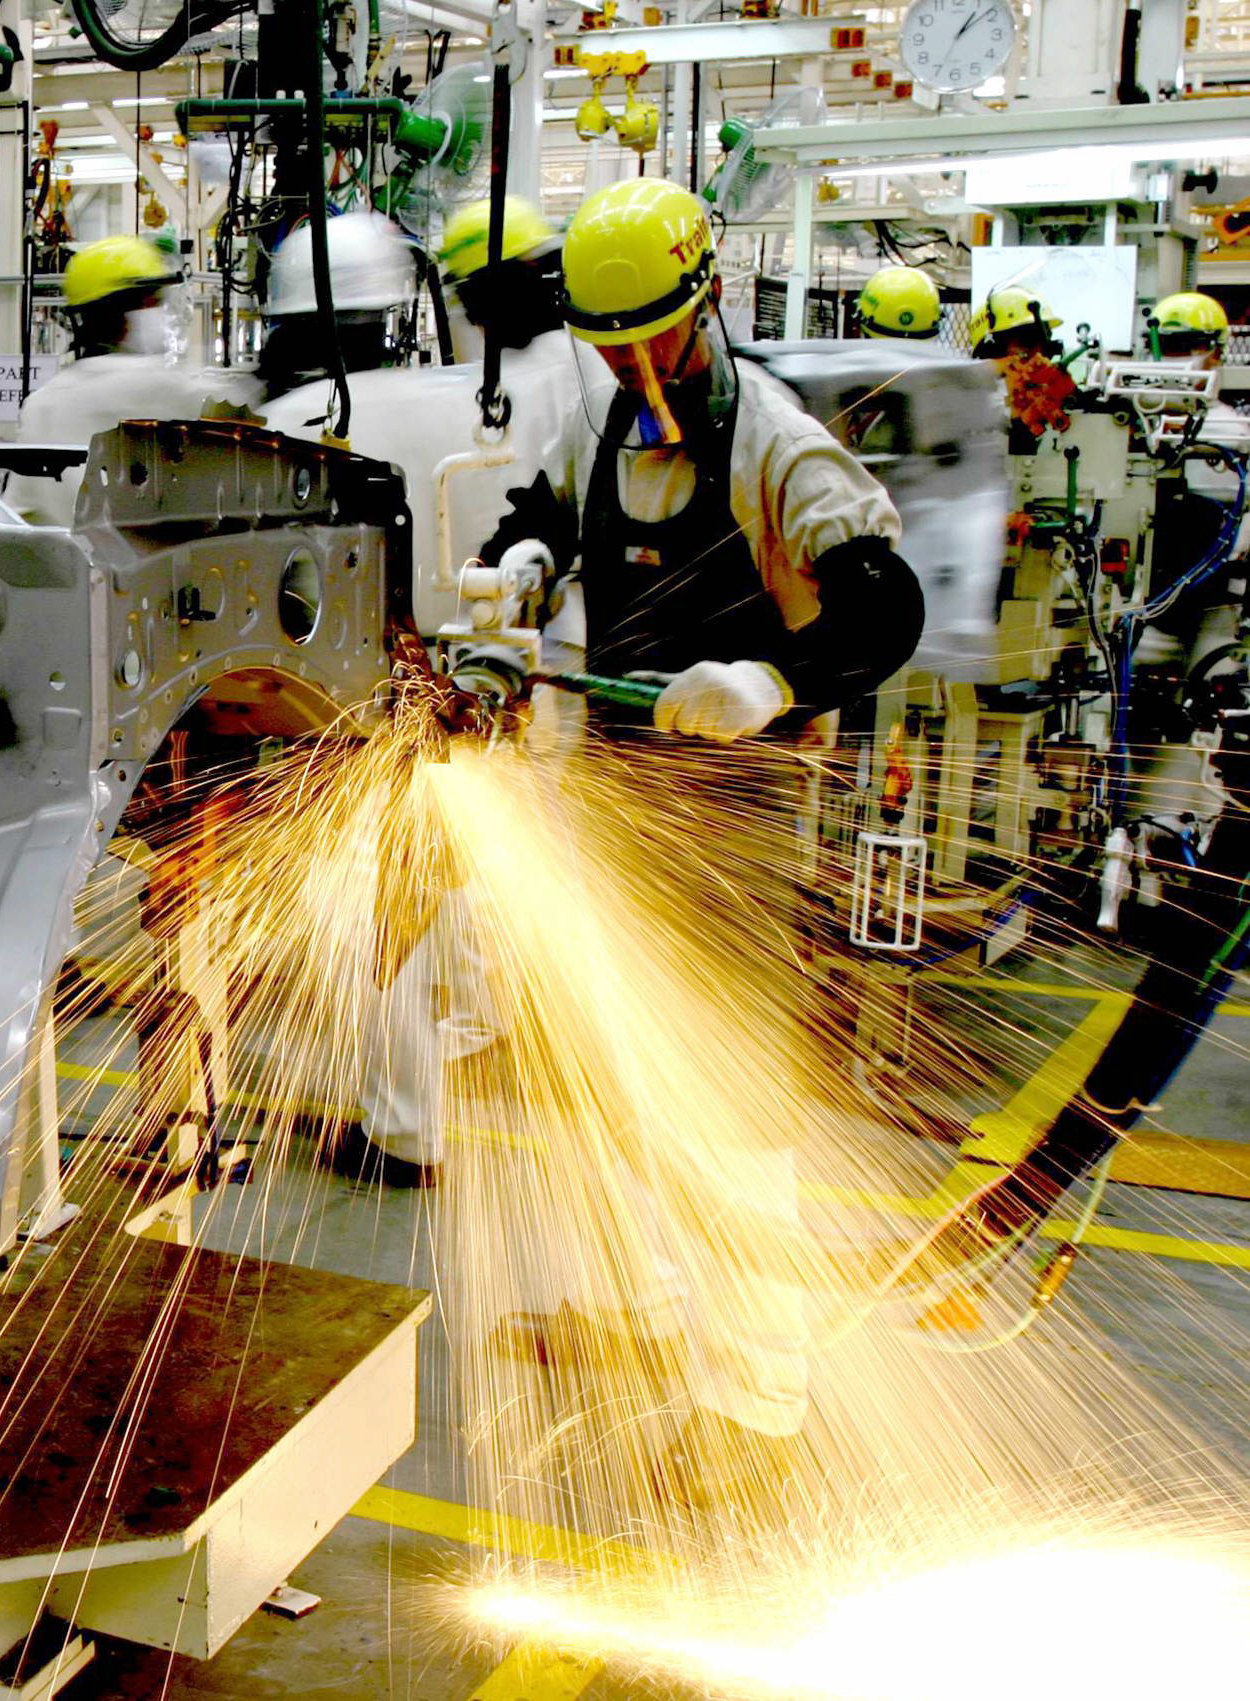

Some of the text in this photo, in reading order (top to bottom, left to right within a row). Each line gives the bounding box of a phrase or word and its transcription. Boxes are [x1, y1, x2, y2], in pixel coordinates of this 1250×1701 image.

[919, 14, 934, 27] 10
[912, 33, 925, 46] 9
[991, 28, 1002, 41] 3
[917, 51, 929, 64] 8
[984, 48, 995, 59] 4
[933, 63, 943, 77] 7
[949, 68, 961, 81] 6
[970, 62, 981, 75] 5
